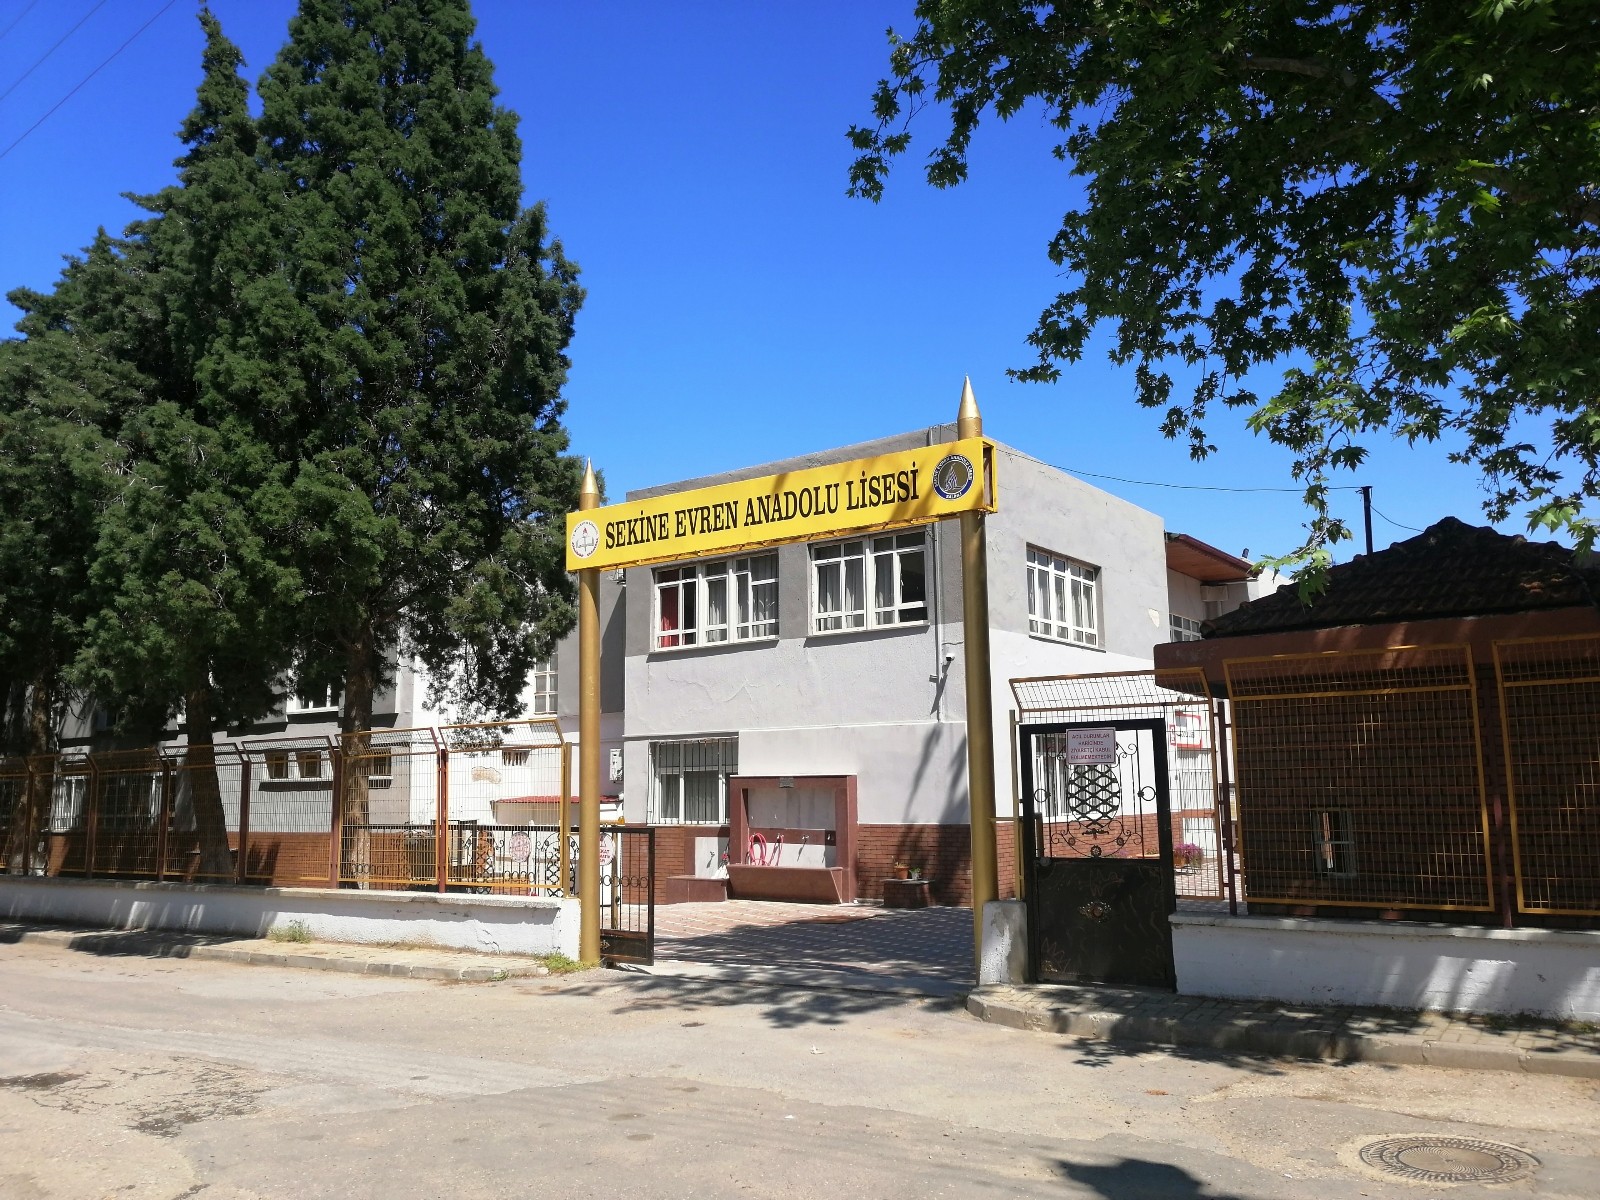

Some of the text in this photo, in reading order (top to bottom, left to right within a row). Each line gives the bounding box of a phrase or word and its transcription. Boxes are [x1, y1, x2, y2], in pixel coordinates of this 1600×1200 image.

[605, 509, 669, 550] SEKİNE
[674, 501, 739, 538] EVREN
[743, 482, 840, 527] ANADOLU
[845, 461, 920, 511] LİSESİ
